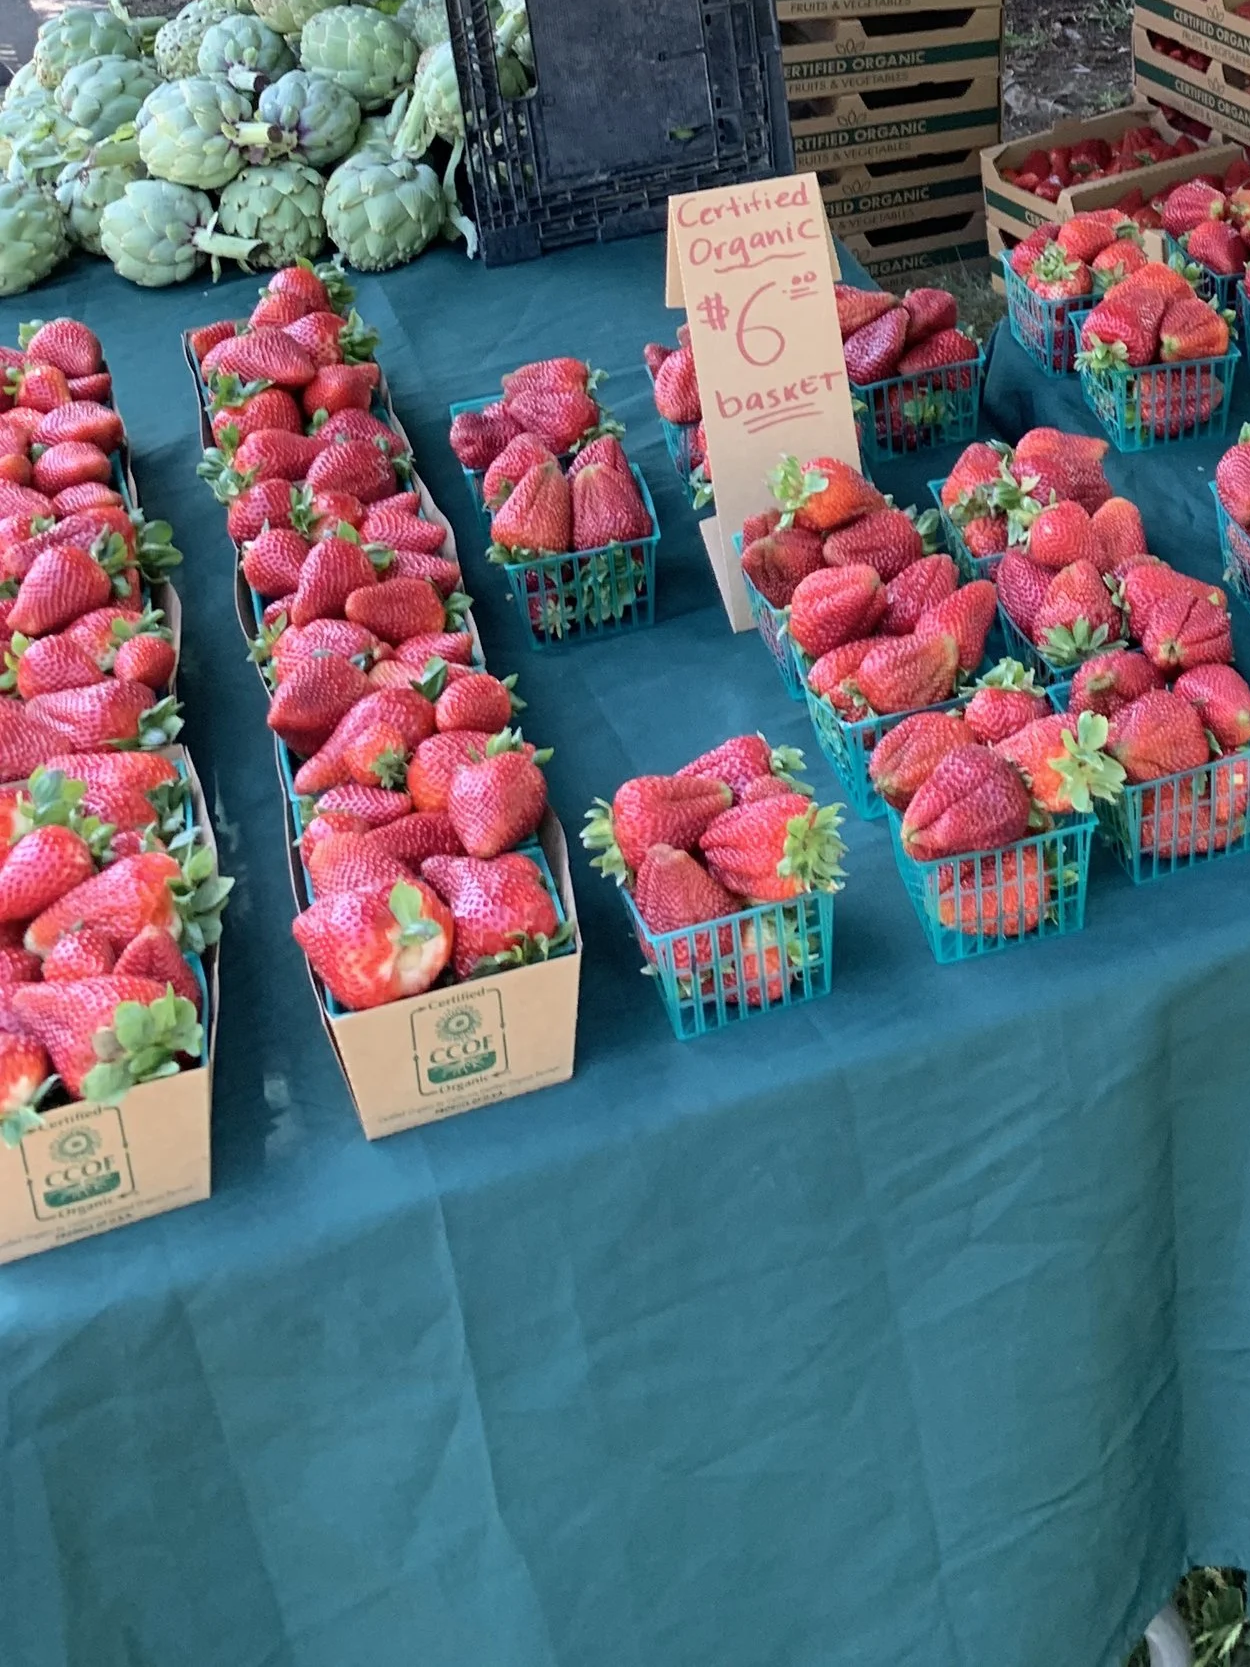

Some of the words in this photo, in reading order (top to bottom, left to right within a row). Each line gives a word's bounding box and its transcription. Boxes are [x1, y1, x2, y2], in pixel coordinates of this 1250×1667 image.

[1174, 9, 1214, 36] CERTIFIED
[783, 60, 847, 78] ERTIFIED
[852, 51, 926, 70] ORGANIC
[1175, 80, 1216, 107] CERTIFIED
[794, 133, 849, 151] RTIFIED
[854, 120, 927, 141] ORGANIC
[677, 182, 810, 227] Certified
[860, 187, 929, 210] ORGANIC
[689, 218, 821, 266] Organic
[868, 255, 929, 275] RGANIC
[428, 987, 487, 1010] Certified
[430, 1034, 493, 1064] CCOF
[45, 1155, 115, 1187] CCOF
